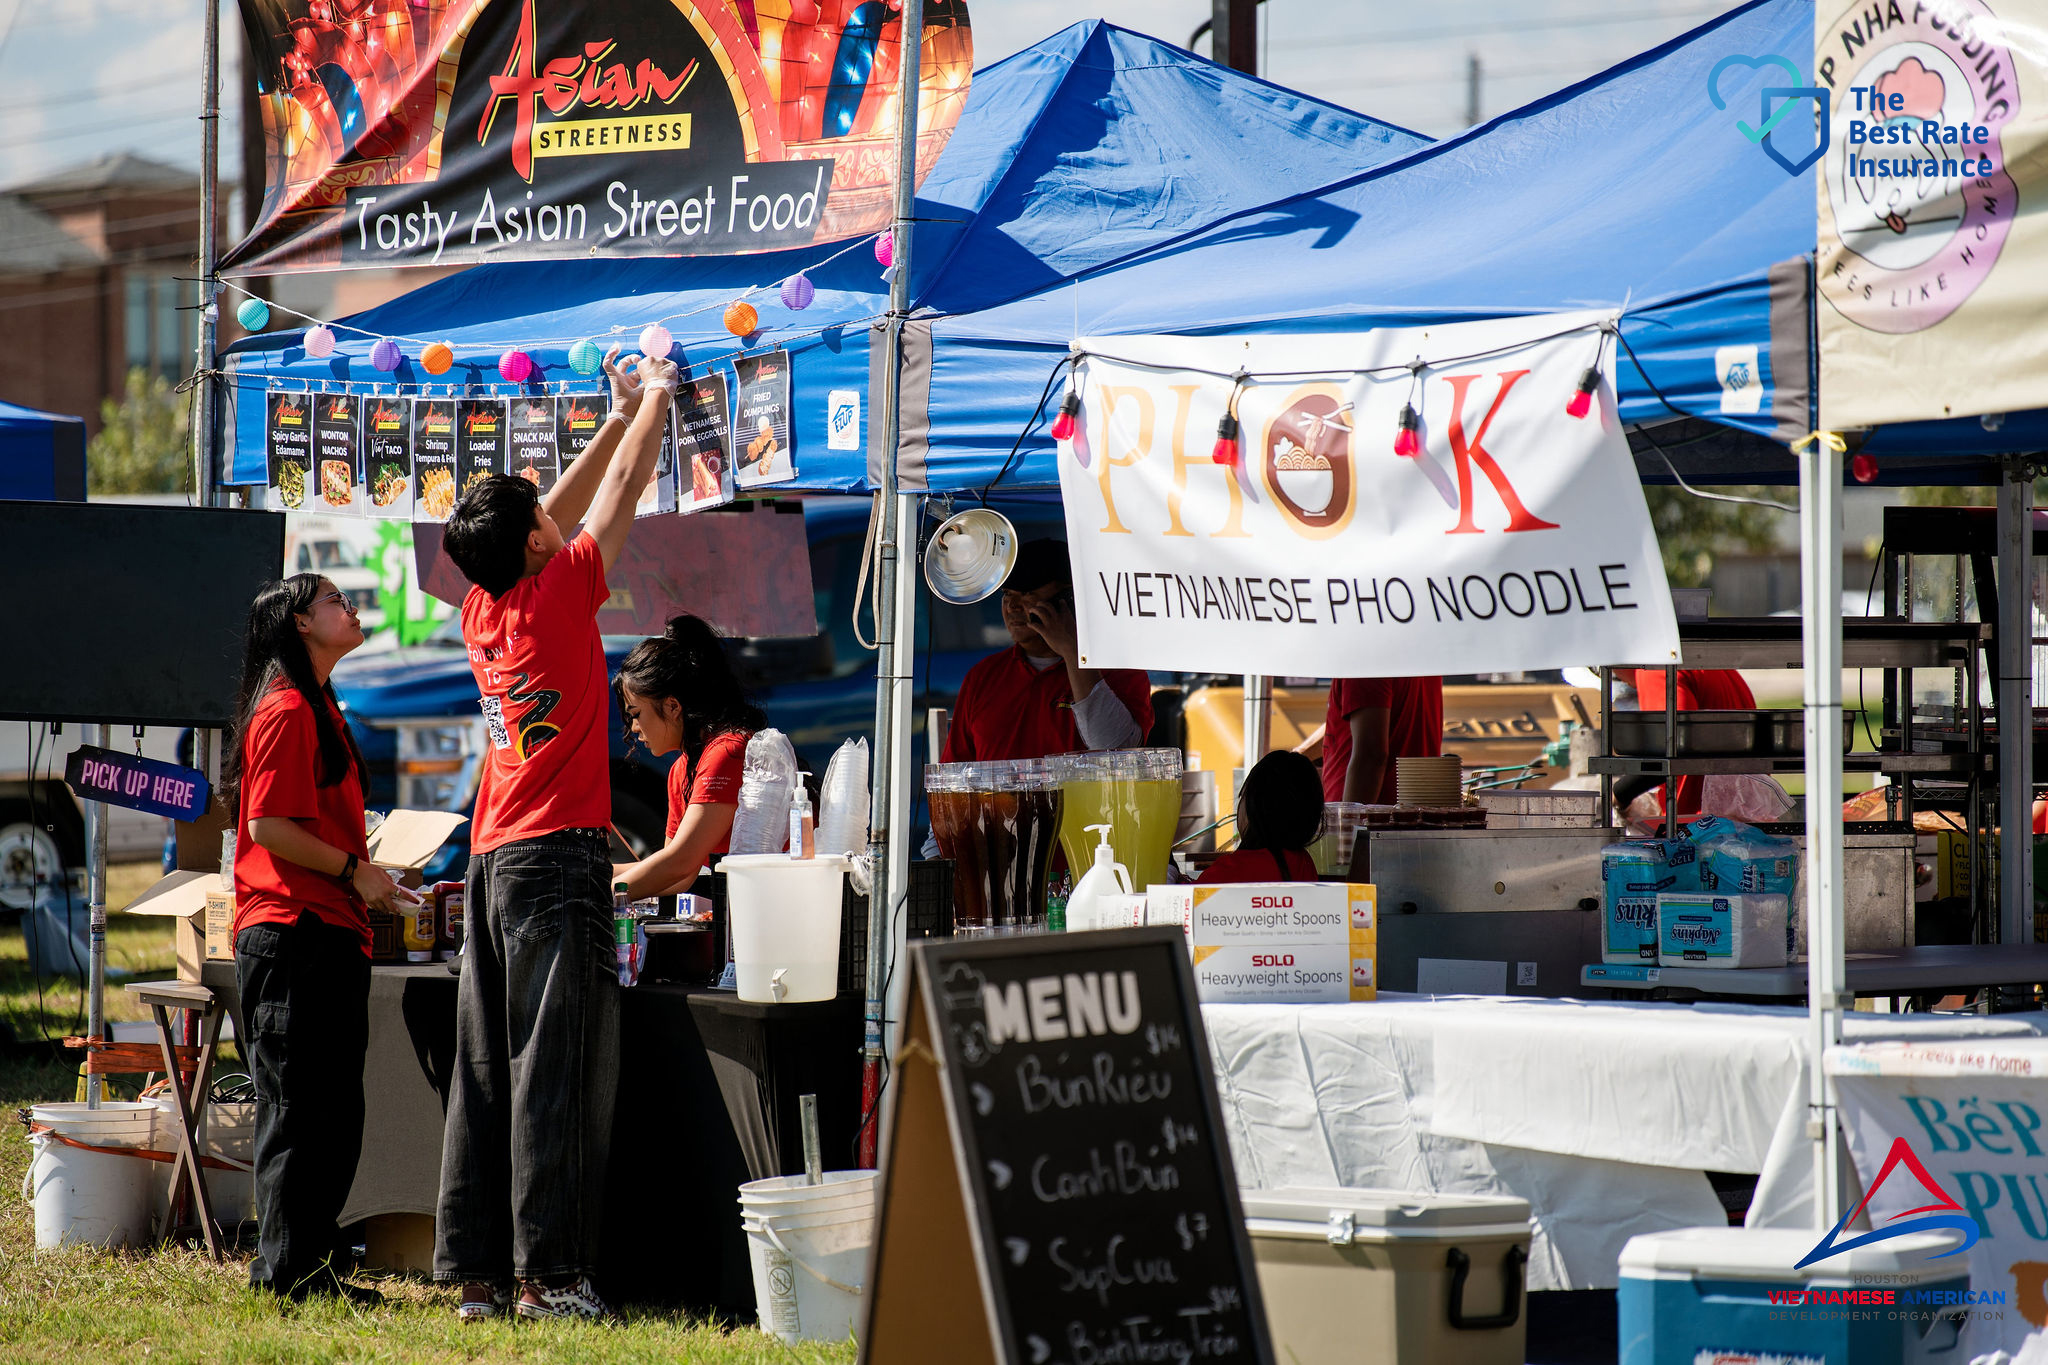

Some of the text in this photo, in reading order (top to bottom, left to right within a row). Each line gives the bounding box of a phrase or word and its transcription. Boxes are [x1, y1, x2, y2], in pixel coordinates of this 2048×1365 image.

[478, 0, 700, 184] Asian
[540, 123, 682, 148] STREETNESS
[355, 166, 823, 262] Tasty Asian Street Food
[1891, 273, 1948, 307] LIKE
[753, 392, 771, 403] FRIED
[743, 404, 779, 418] DUMPLINGS
[682, 415, 721, 432] VIETNAMESE
[272, 431, 308, 443] Spicy Garlic
[321, 430, 348, 441] WONTON
[513, 432, 537, 443] SNACK
[679, 434, 696, 447] PORK
[697, 426, 728, 441] EGGROLLS
[275, 445, 305, 456] Edamame
[322, 446, 347, 456] NACHOS
[385, 446, 402, 454] TACO
[426, 440, 448, 452] Shrimp
[469, 440, 495, 451] Loaded
[520, 447, 547, 458] COMBO
[415, 454, 440, 464] Tempura
[442, 454, 446, 462] &
[475, 455, 491, 466] Fries
[1096, 370, 1560, 541] PHO K
[1099, 564, 1638, 625] VIETNAMESE PHO NOODLE
[483, 668, 501, 686] To
[81, 759, 195, 809] PICK UP HERE
[1251, 896, 1293, 908] SOLO
[1201, 912, 1341, 928] Heavyweight Spoons
[1672, 923, 1721, 945] Napkins
[1252, 954, 1294, 966] SOLO
[1201, 970, 1342, 987] Heavyweight Spoons
[983, 971, 1142, 1045] MENU
[1990, 1055, 2032, 1074] home
